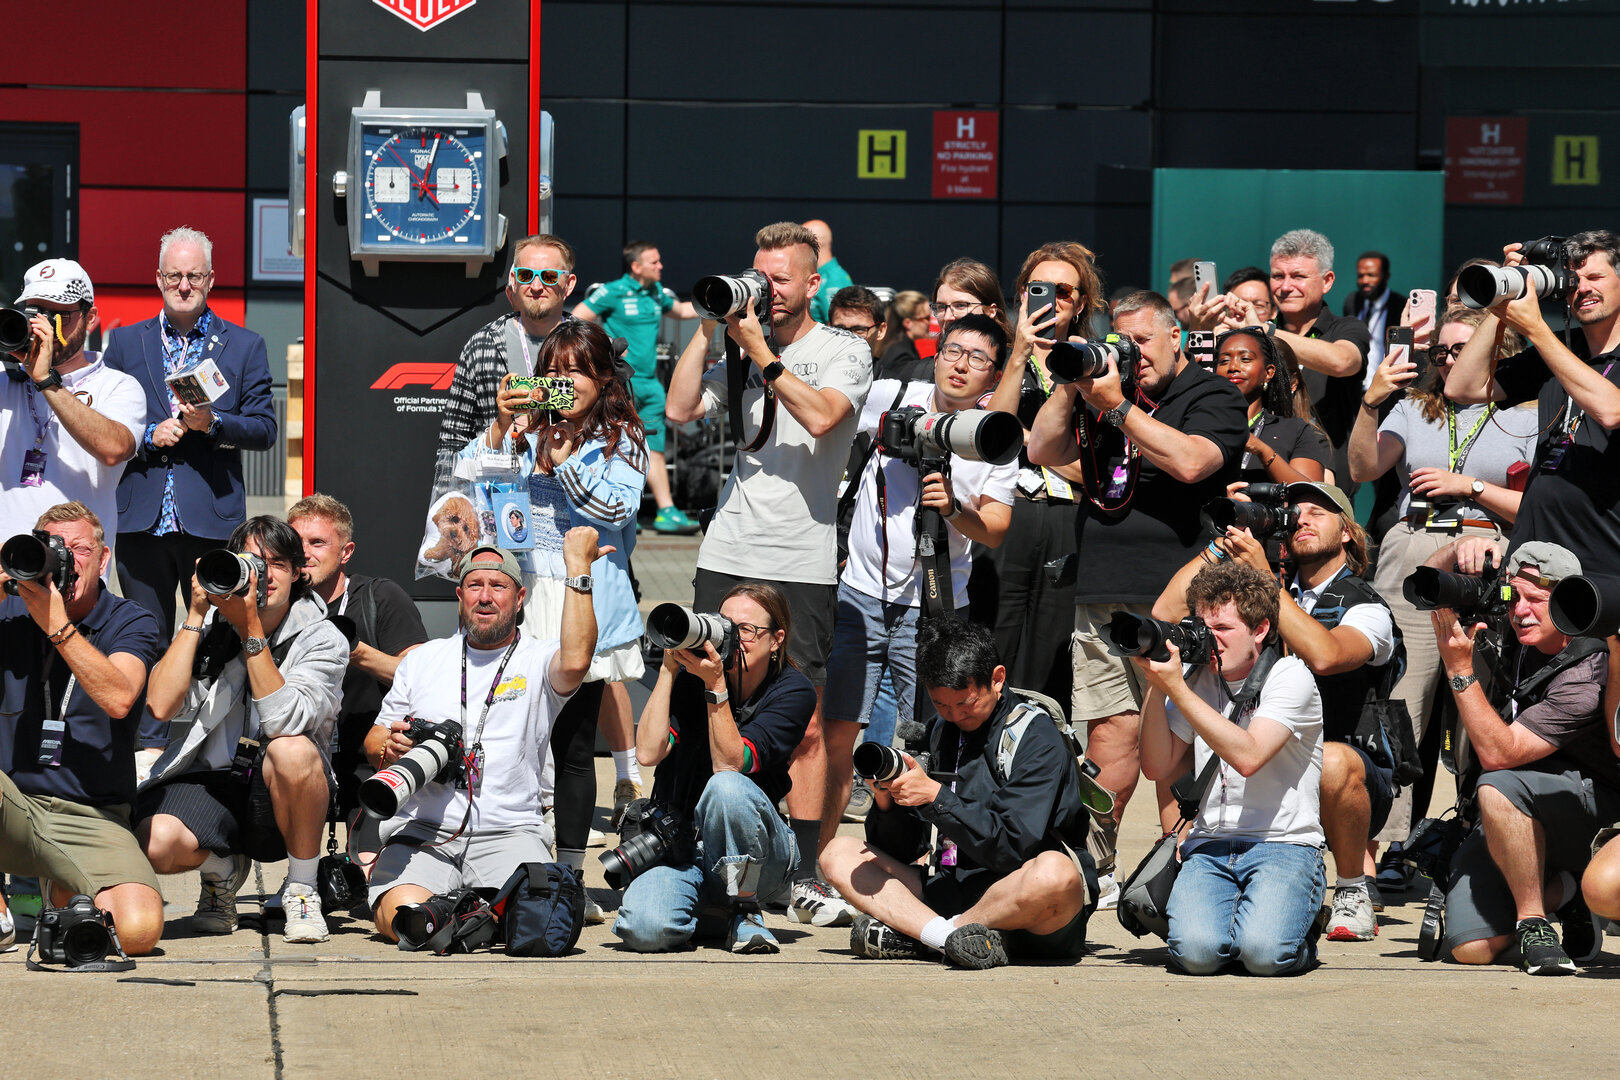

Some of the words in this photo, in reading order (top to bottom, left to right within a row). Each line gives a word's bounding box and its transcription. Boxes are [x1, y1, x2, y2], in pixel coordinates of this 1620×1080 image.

[956, 117, 975, 139] H
[867, 134, 897, 174] H
[936, 151, 952, 161] NO
[952, 151, 994, 161] PARKING
[943, 141, 988, 150] STRICTLY
[393, 396, 420, 404] Official
[420, 397, 449, 405] Partner
[1079, 413, 1089, 449] Canon
[927, 568, 938, 599] Canon
[1443, 729, 1451, 751] Nikon
